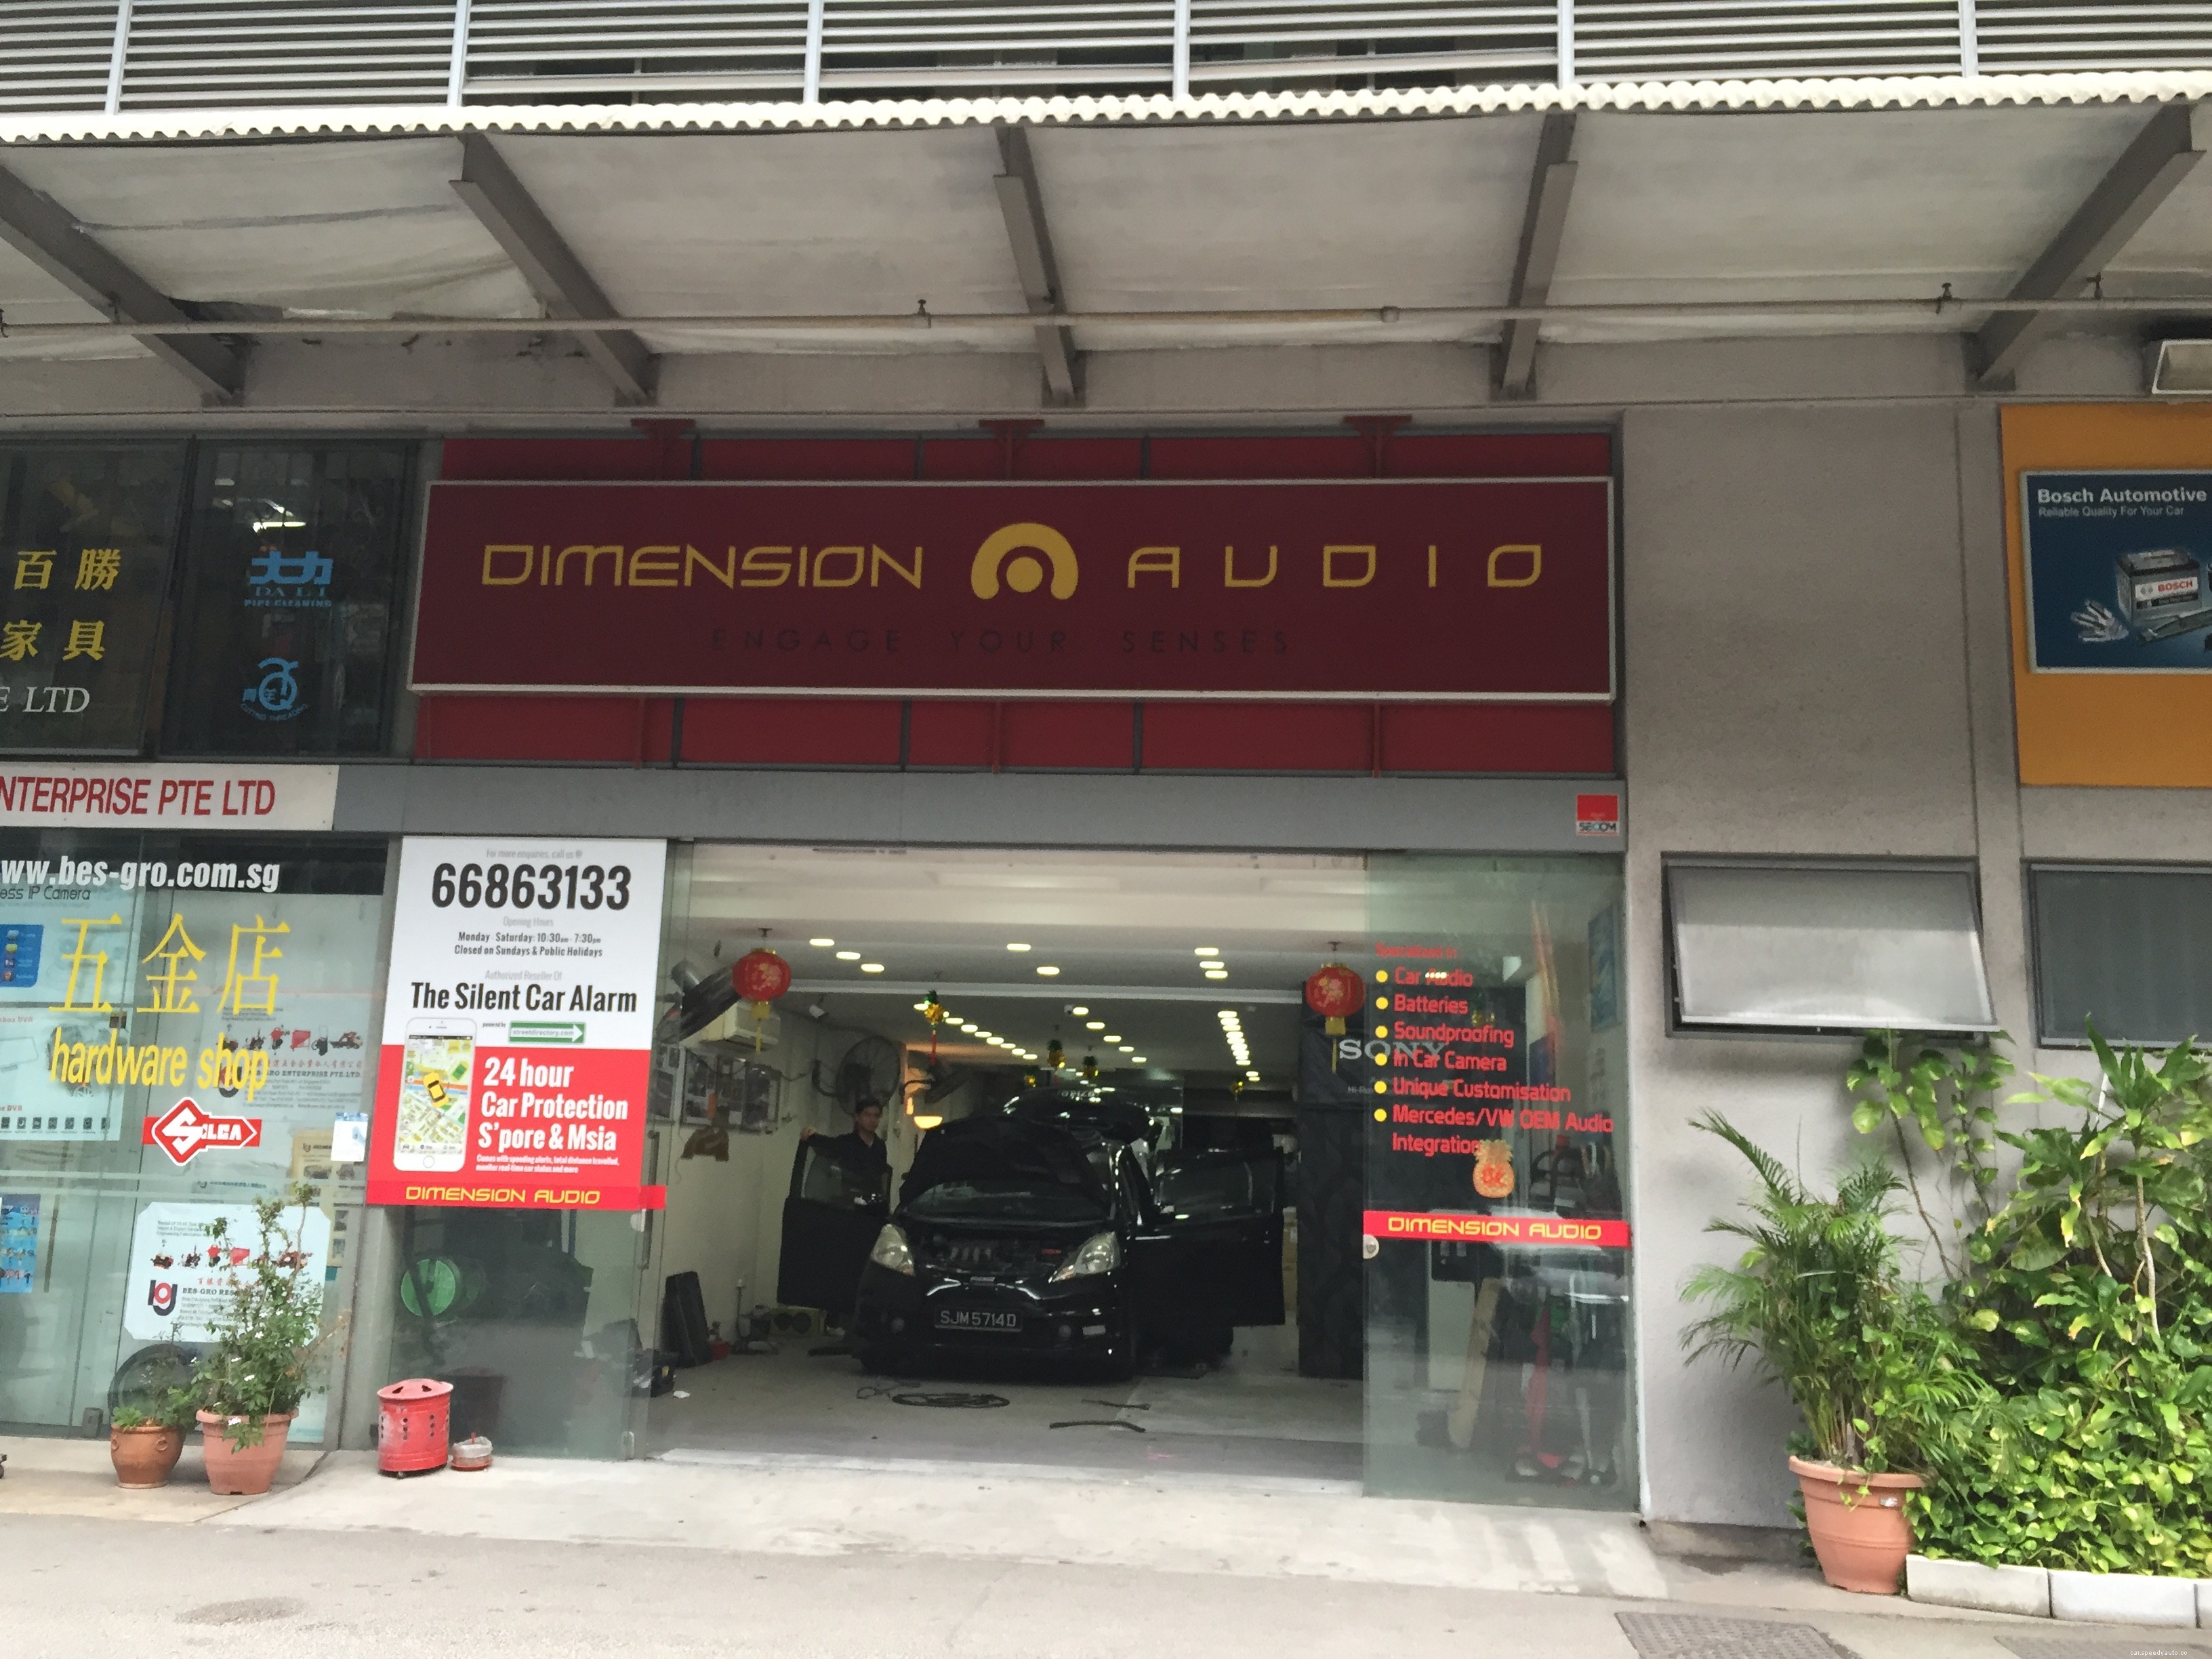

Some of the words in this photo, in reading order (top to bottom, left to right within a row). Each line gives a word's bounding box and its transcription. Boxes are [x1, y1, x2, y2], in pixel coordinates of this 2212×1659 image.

[2037, 487, 2094, 504] Bosch
[2100, 486, 2207, 504] Automotive
[2082, 506, 2117, 518] Quality
[2121, 506, 2137, 516] For
[2139, 506, 2163, 516] Your
[2166, 505, 2184, 515] Car
[14, 548, 121, 590] 百勝
[481, 544, 924, 589] DIMENSION
[1127, 544, 1542, 589] AUDIO
[2158, 580, 2193, 592] BOSCH
[712, 628, 901, 653] ENGAGE
[950, 629, 1068, 655] YOUR
[1122, 630, 1288, 655] SENSES
[22, 686, 91, 713] LTD
[0, 776, 151, 815] NTERPRISE
[158, 779, 212, 816] PTE
[222, 779, 276, 816] LTD
[28, 885, 41, 900] IP
[43, 885, 91, 900] Camera
[431, 863, 632, 910] 66863133
[503, 916, 532, 928] Opening
[533, 917, 554, 926] Hours
[458, 931, 490, 943] Monday
[49, 912, 291, 1015] 五金店
[454, 944, 483, 955] Closed
[484, 947, 493, 955] on
[495, 945, 531, 956] Sundays
[532, 945, 538, 956] &
[539, 946, 565, 956] Public
[567, 947, 603, 958] Holidays
[485, 969, 523, 980] Authorized
[524, 970, 553, 981] Reseller
[1394, 966, 1421, 985] Car
[411, 982, 449, 1010] The
[455, 983, 520, 1010] Silent
[525, 983, 566, 1011] Car
[569, 985, 638, 1012] Alarm
[1393, 994, 1469, 1015] Batteries
[1393, 1021, 1515, 1048] Soundproofing
[49, 1026, 188, 1087] hardware
[197, 1031, 270, 1103] shop
[483, 1056, 516, 1088] 24
[520, 1057, 575, 1088] hour
[1412, 1049, 1439, 1069] Car
[1444, 1050, 1507, 1071] Camera
[1393, 1076, 1449, 1099] Unique
[1452, 1078, 1571, 1102] Customisation
[480, 1090, 518, 1119] Car
[520, 1091, 629, 1120] Protection
[1392, 1104, 1514, 1128] Mercedes/VW
[1519, 1109, 1560, 1130] OEM
[1565, 1113, 1614, 1133] Audio
[477, 1122, 546, 1153] S'pore
[549, 1124, 565, 1149] &
[567, 1122, 617, 1151] Msia
[405, 1187, 526, 1203] DIMENSION
[533, 1188, 600, 1204] AUDIO
[1387, 1216, 1519, 1237] DIMENSION
[1529, 1223, 1602, 1240] AUDIO
[940, 1310, 1017, 1328] SJM5714D
